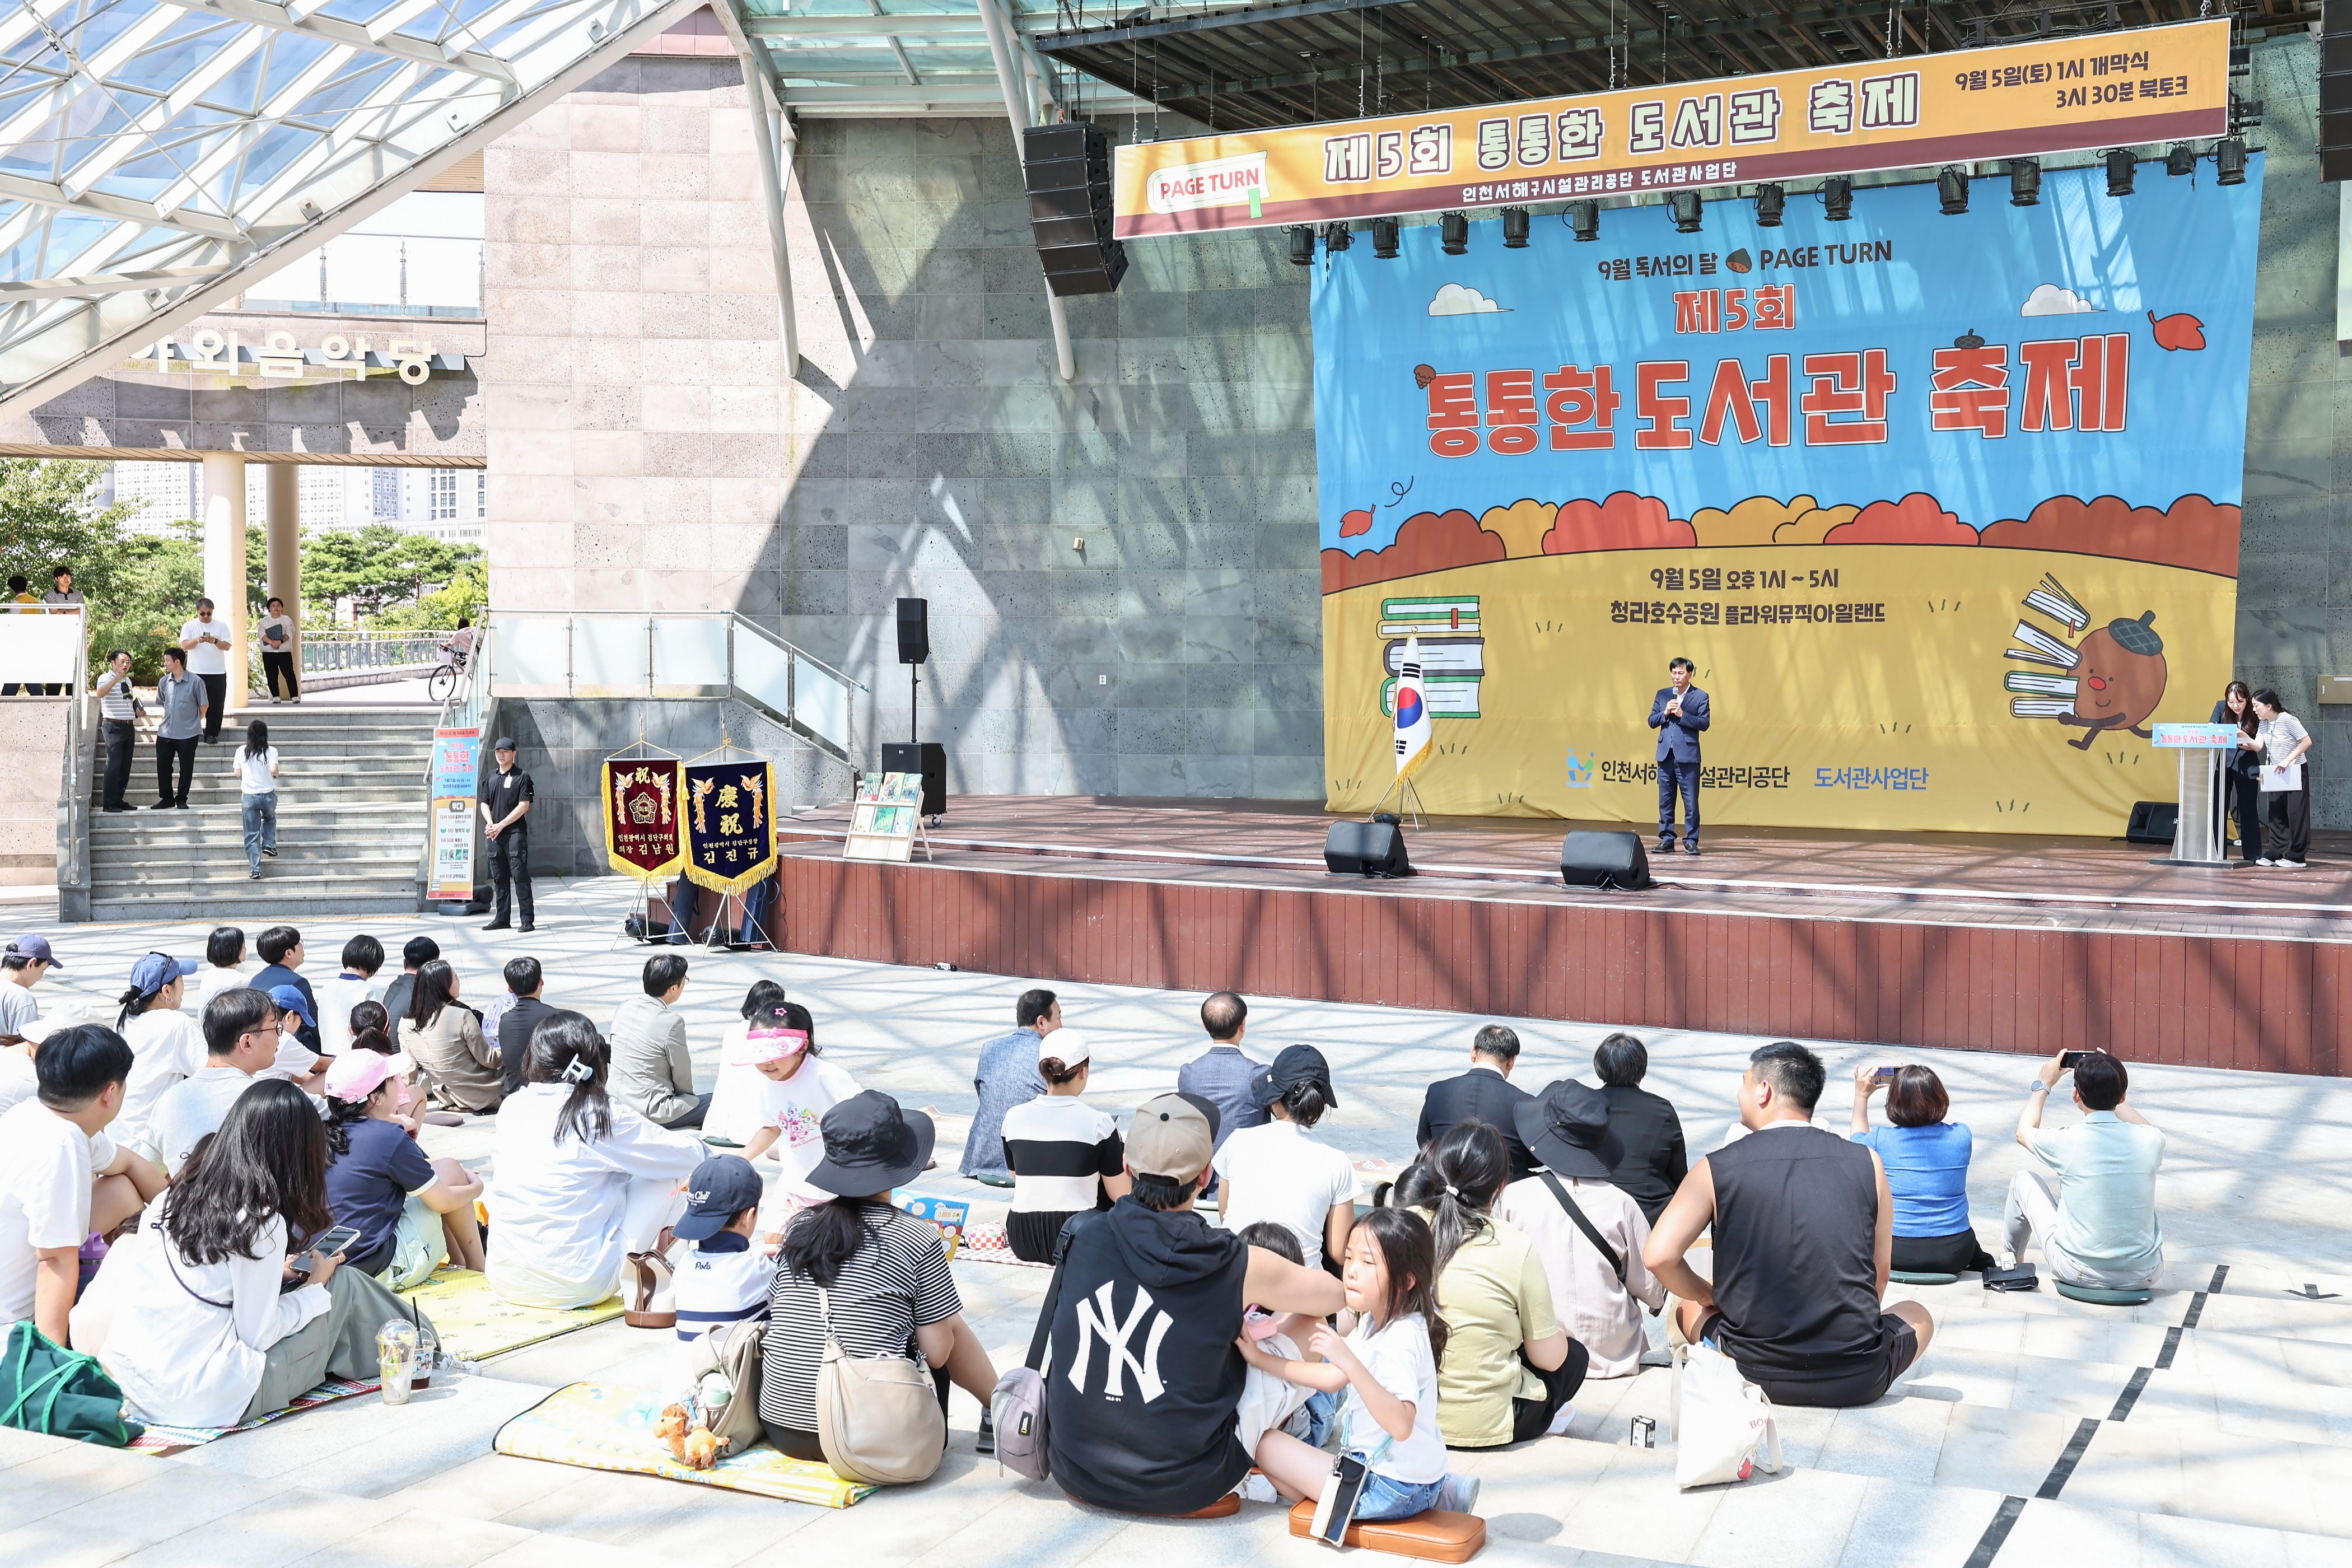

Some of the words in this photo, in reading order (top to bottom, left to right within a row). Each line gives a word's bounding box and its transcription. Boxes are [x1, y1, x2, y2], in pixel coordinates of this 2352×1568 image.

[1955, 69, 1986, 91] 9월
[1992, 62, 2052, 87] 5일(토)
[2057, 58, 2084, 80] 1시
[2090, 51, 2149, 76] 개막식
[2056, 86, 2087, 108] 3시
[2092, 81, 2134, 105] 30분
[2139, 76, 2188, 99] 북토크
[1323, 123, 1453, 185] 제5회
[1476, 107, 1605, 171] 통통한
[1628, 86, 1782, 156] 도서관
[1808, 71, 1920, 135] 축제
[1160, 176, 1204, 199] PAGE
[1208, 167, 1259, 192] TURN
[1462, 171, 1634, 203] 인천서해구시설관리공단
[1641, 161, 1737, 186] 도서관사업단
[1598, 257, 1631, 281] 9월
[1636, 254, 1693, 277] 독서의
[1699, 252, 1718, 276] 달
[1760, 246, 1819, 270] PAGE
[1824, 240, 1892, 265] TURN
[1673, 283, 1795, 334] 제5회
[1426, 364, 1621, 458] 통통한
[1635, 348, 1897, 450] 도서관
[1930, 332, 2130, 438] 축제
[1650, 568, 1684, 590] 9월
[1689, 568, 1721, 590] 5일
[1726, 570, 1755, 590] 오후
[1760, 570, 1786, 589] 1시
[1809, 568, 1839, 587] 5시
[1611, 600, 1720, 625] 청라호수공원
[1725, 603, 1886, 625] 플라워뮤직아일랜드
[2162, 735, 2181, 743] 통통한
[2183, 735, 2207, 744] 도서관
[2210, 735, 2228, 744] 축제
[439, 764, 459, 773] 도서관
[445, 750, 469, 763] 통통한
[635, 767, 651, 785] 祝
[1814, 767, 1929, 790] 도서관사업단
[452, 802, 464, 810] 무대
[618, 834, 646, 842] 인천광역시
[647, 833, 673, 842] 검단구의회
[619, 845, 634, 854] 의장
[702, 841, 730, 849] 인천광역시
[731, 838, 758, 846] 검단구청장
[1068, 1279, 1174, 1403] NY
